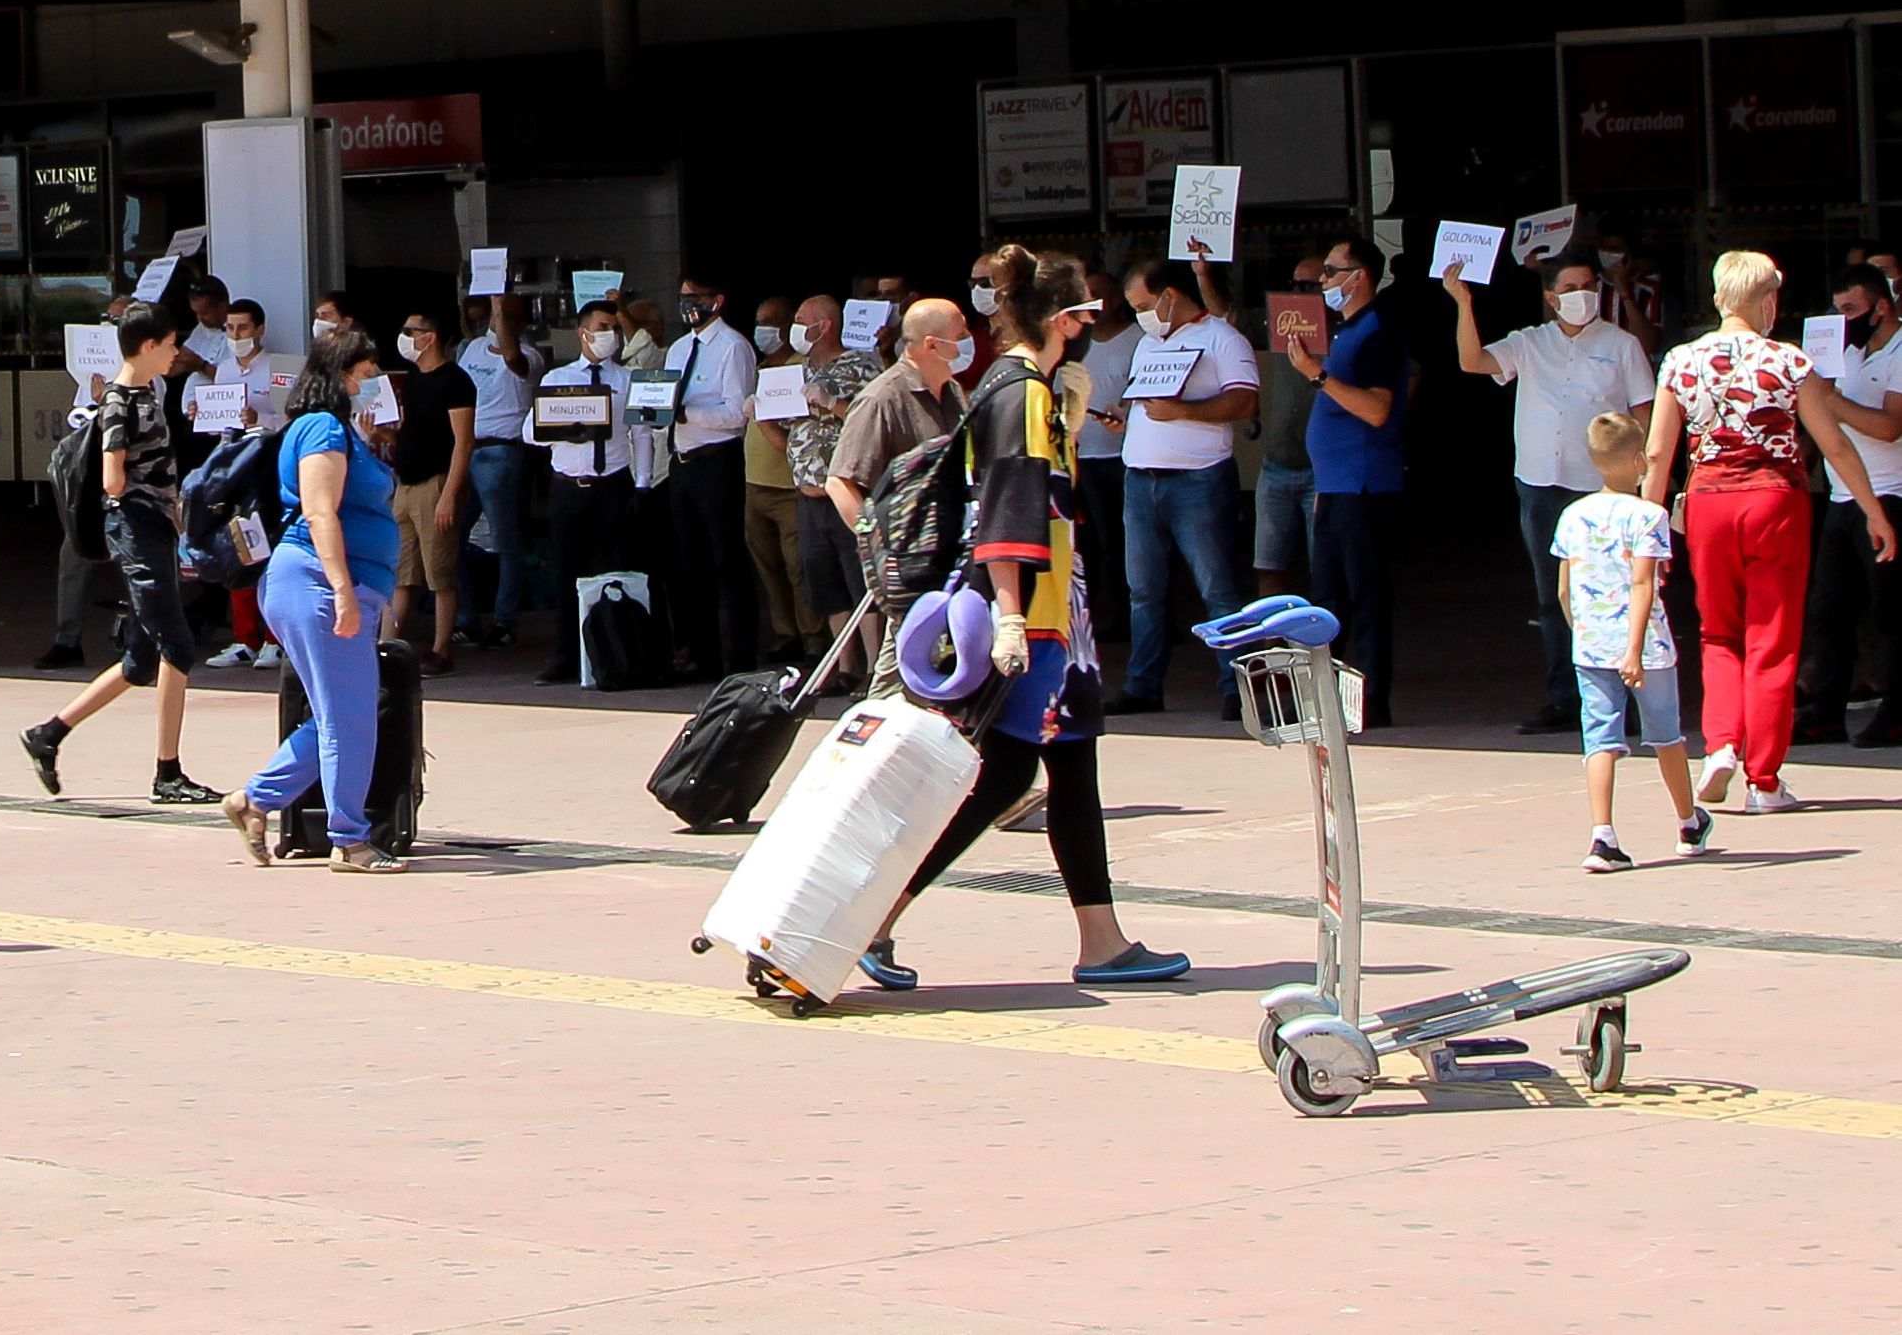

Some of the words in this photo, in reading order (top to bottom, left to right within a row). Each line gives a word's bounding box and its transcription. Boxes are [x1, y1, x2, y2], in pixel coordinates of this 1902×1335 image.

[1129, 88, 1208, 130] Akdem
[1754, 103, 1838, 128] corendon
[338, 113, 445, 151] odafone
[1605, 109, 1685, 134] corendon
[35, 165, 98, 186] XCLUSIVE
[1024, 184, 1087, 203] holidayline
[1173, 204, 1233, 226] SeaSons
[1442, 231, 1493, 247] GOLOVINA
[1450, 252, 1474, 265] ANNA
[205, 390, 235, 402] ARTEM
